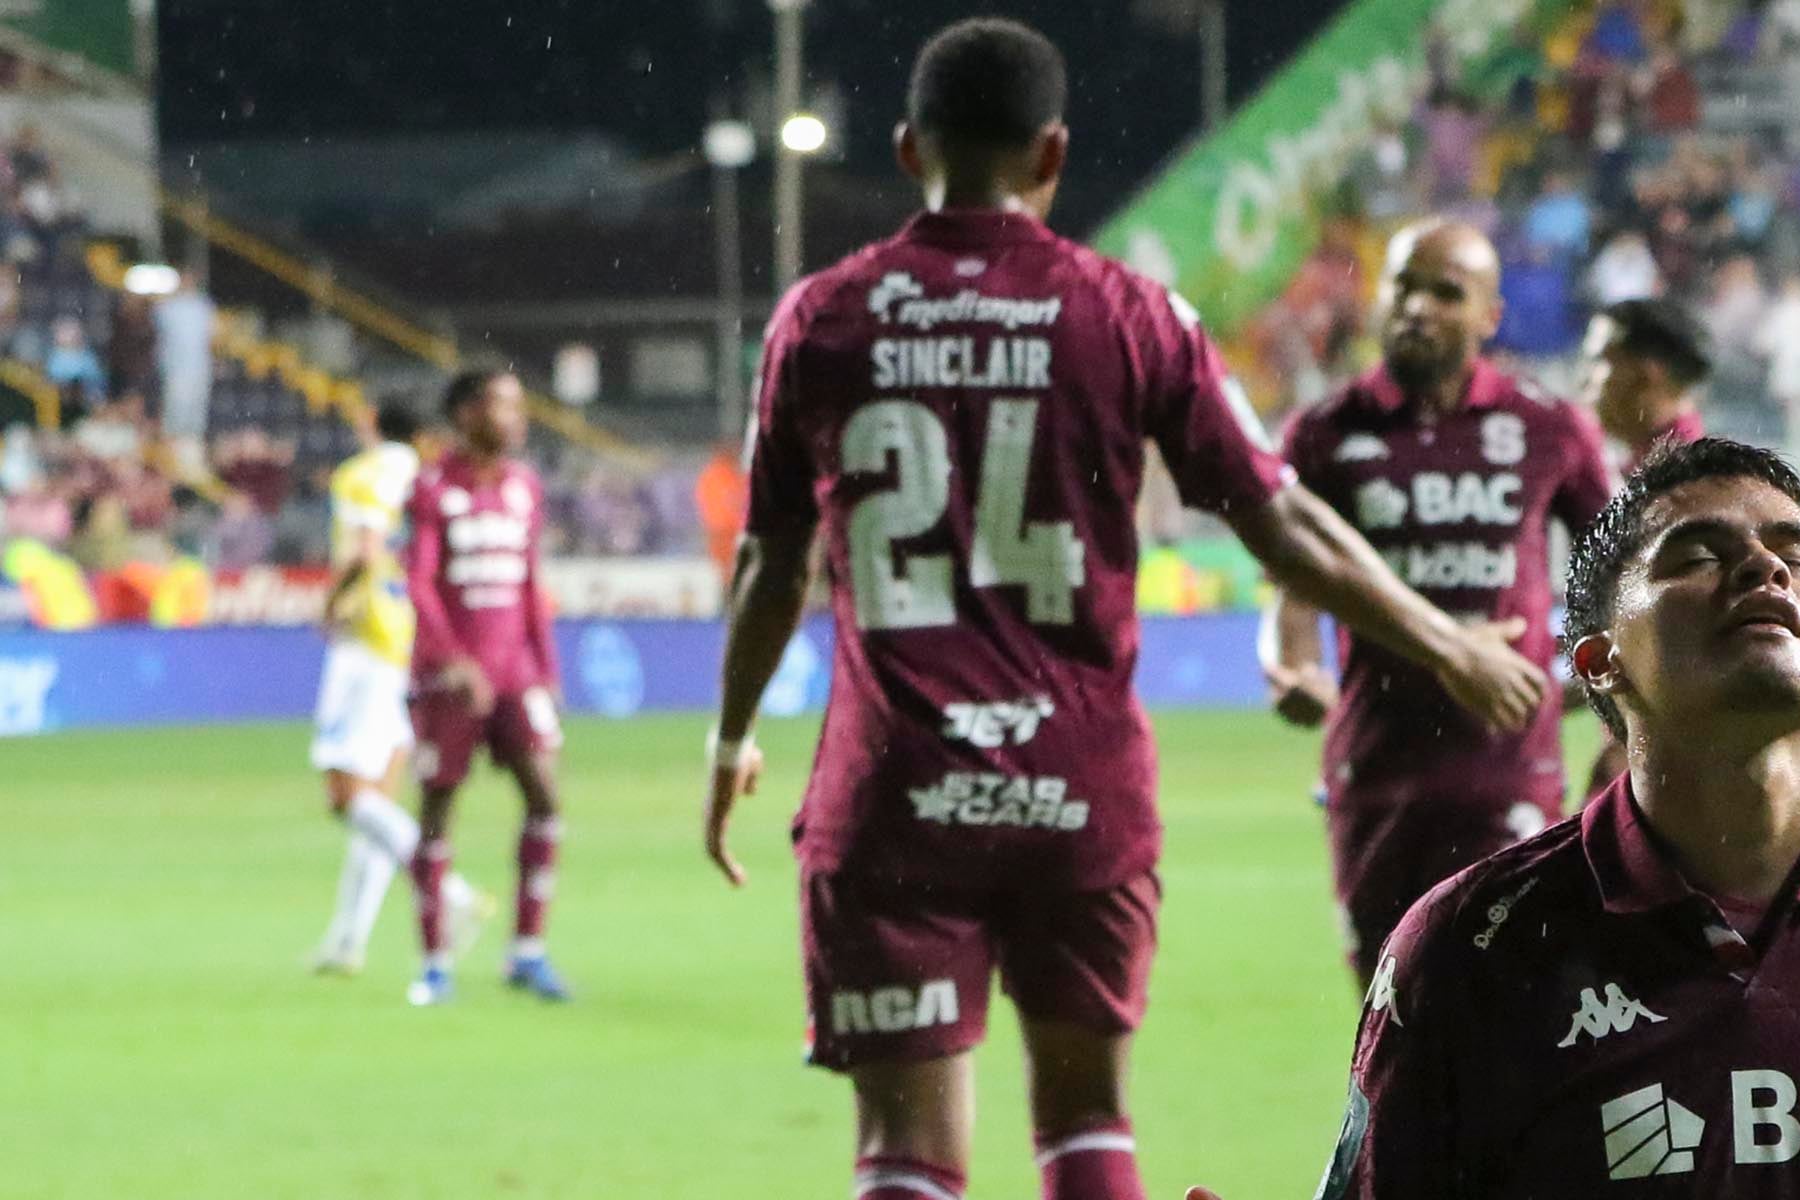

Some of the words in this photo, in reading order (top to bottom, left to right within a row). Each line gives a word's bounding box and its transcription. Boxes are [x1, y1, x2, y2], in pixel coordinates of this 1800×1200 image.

[871, 337, 1052, 388] SINCLAIR
[1480, 413, 1528, 466] S
[838, 398, 1086, 630] 24
[1411, 472, 1523, 526] BAC
[956, 800, 1090, 831] CARS
[832, 978, 959, 1034] RCA
